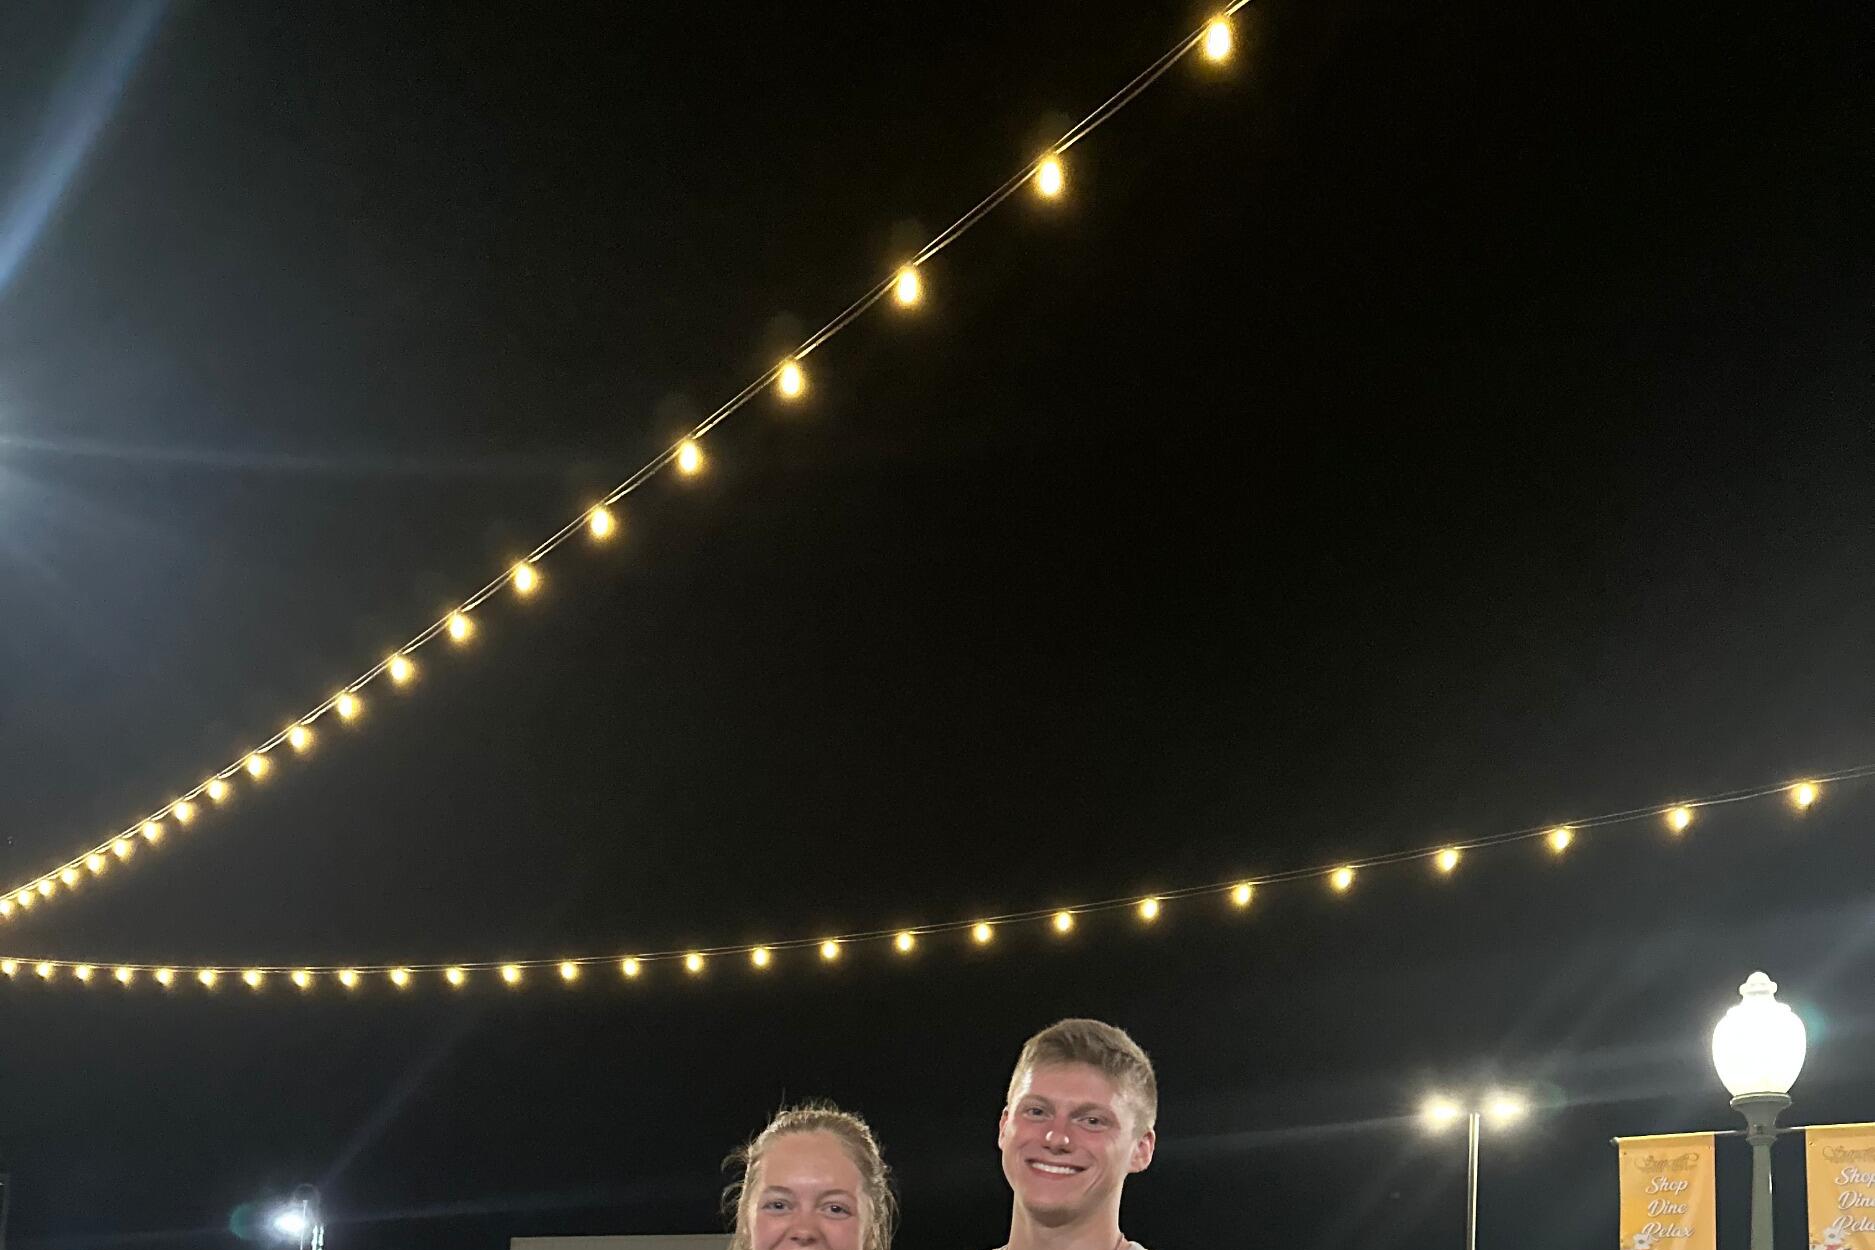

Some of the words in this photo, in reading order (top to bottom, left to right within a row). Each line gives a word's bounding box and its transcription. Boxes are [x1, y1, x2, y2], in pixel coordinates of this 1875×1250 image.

[1645, 1175, 1689, 1195] Shop
[1647, 1198, 1688, 1218] Dine
[1641, 1221, 1695, 1241] Relax
[1832, 1214, 1875, 1236] Rela
